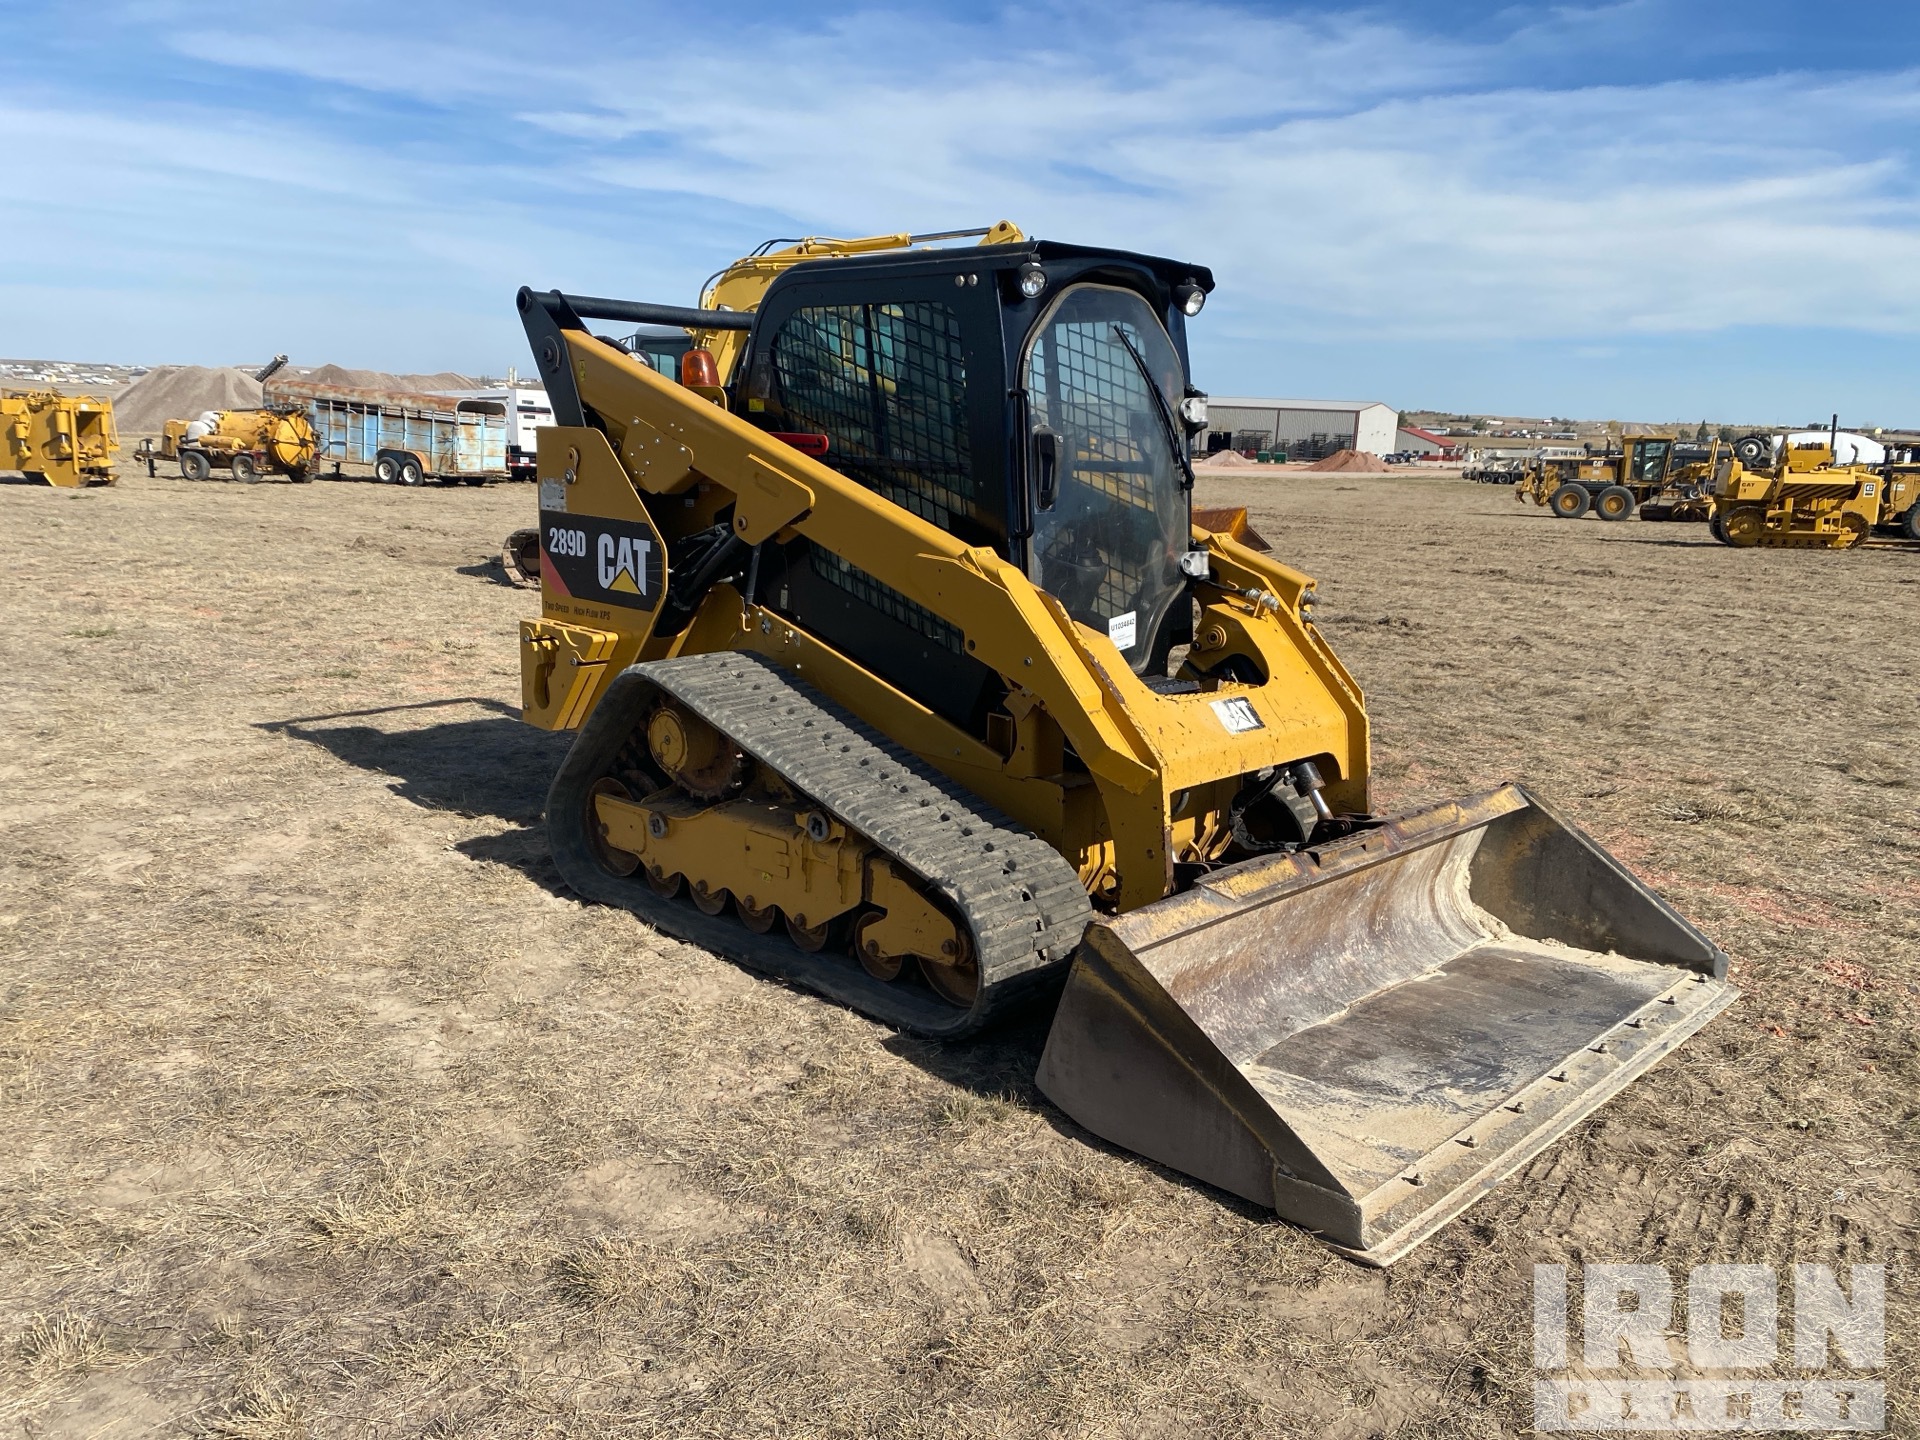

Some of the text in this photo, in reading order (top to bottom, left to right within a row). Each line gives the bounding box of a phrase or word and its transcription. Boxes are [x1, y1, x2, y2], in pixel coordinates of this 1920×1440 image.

[549, 527, 586, 557] 289D
[597, 533, 650, 596] CAT
[600, 610, 610, 620] XPS
